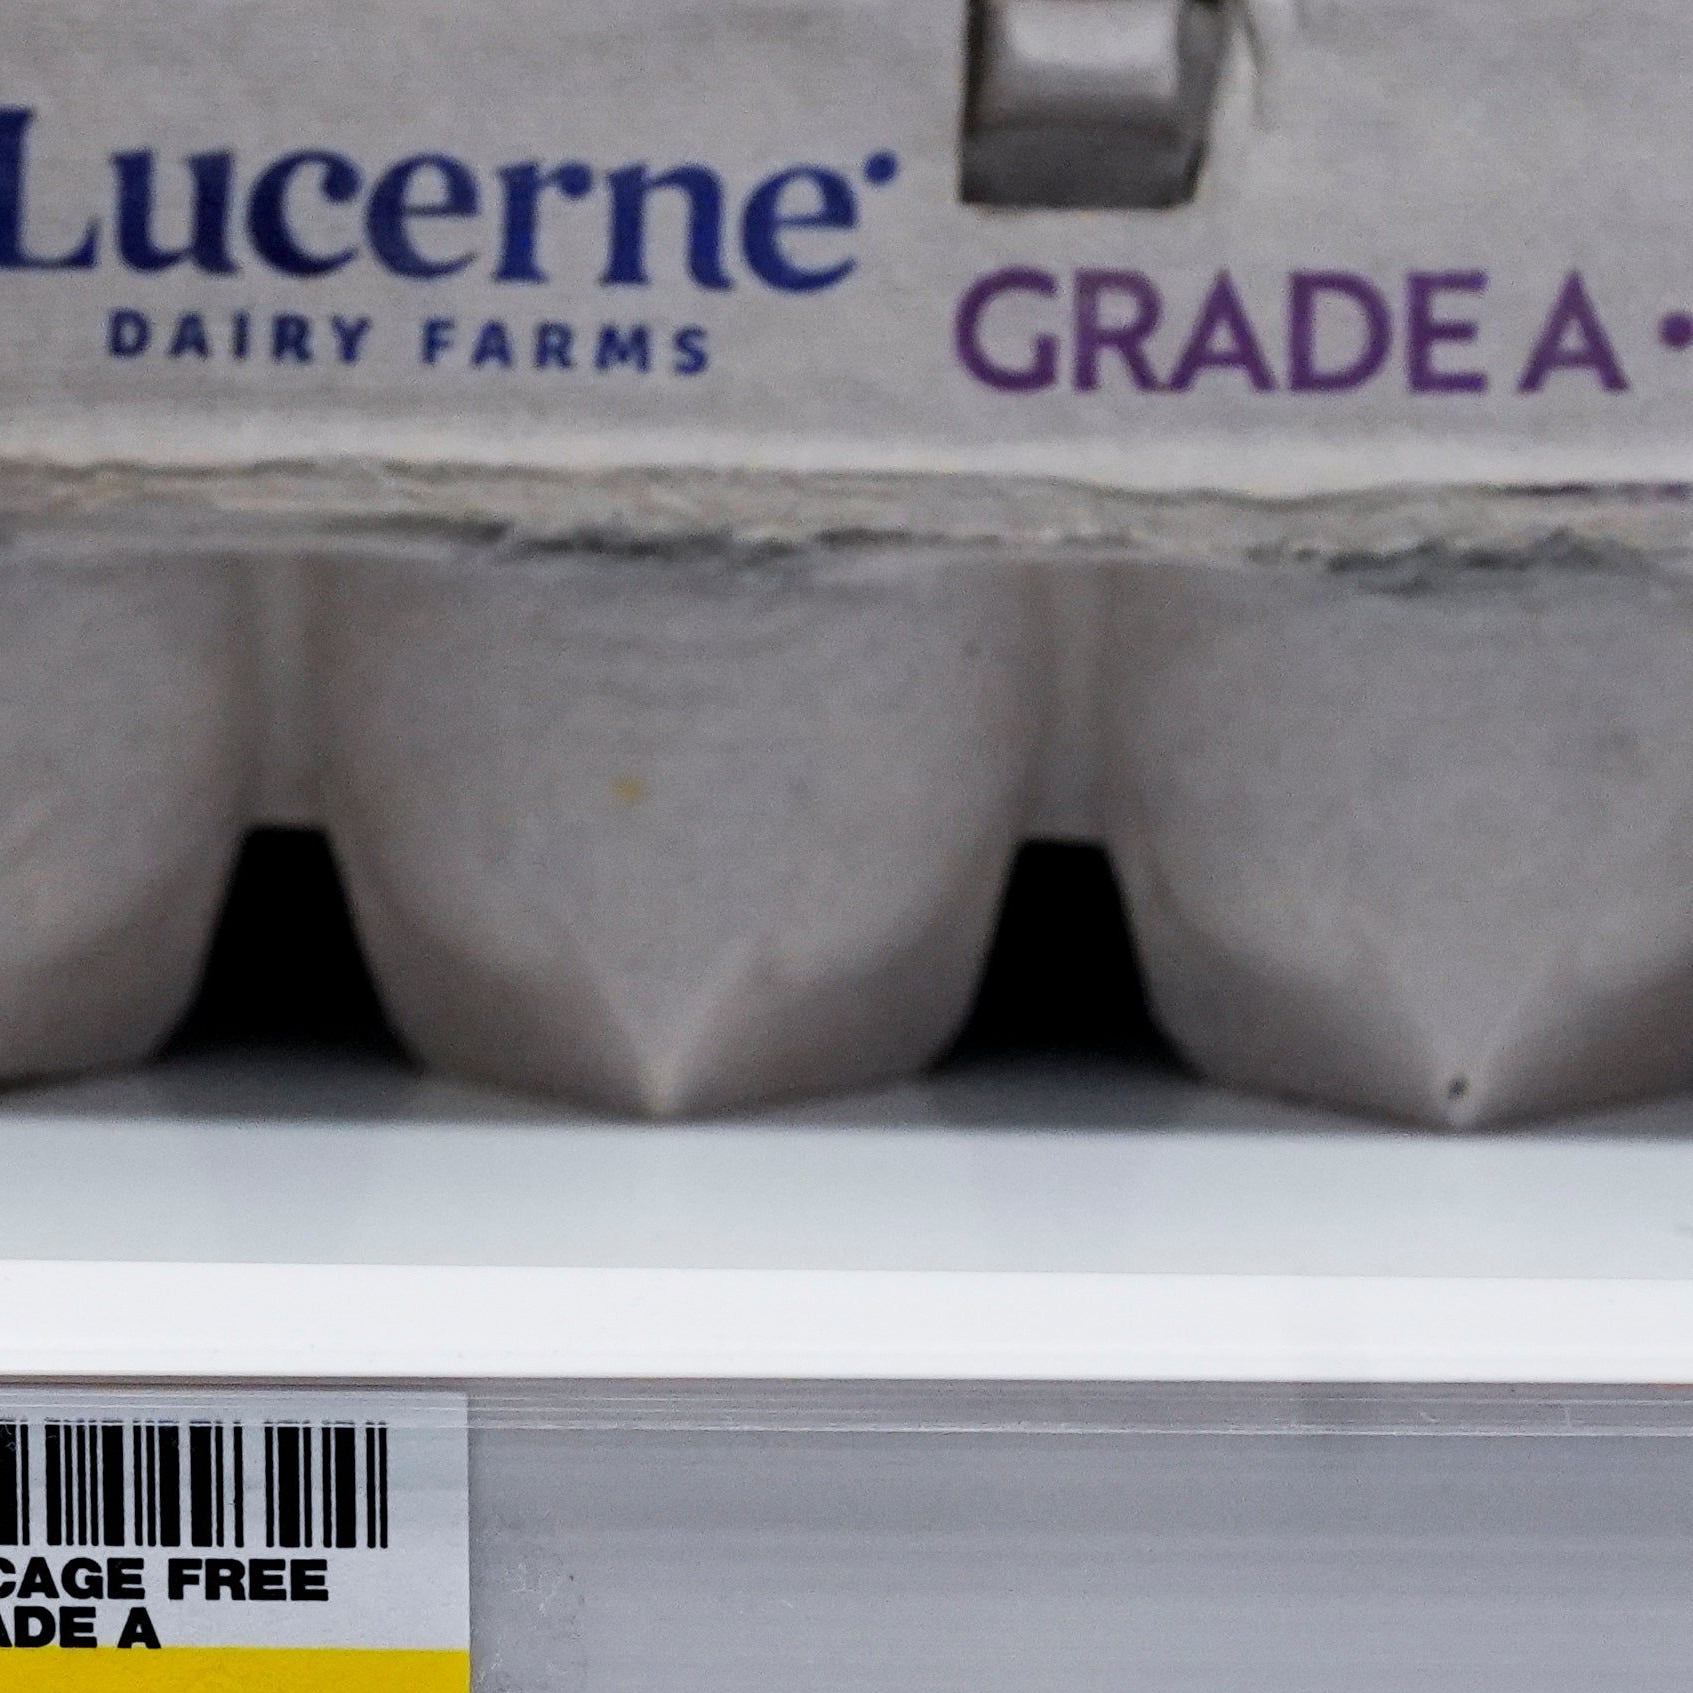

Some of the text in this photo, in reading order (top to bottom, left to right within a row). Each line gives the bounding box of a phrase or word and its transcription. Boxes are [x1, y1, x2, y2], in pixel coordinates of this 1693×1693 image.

[107, 308, 711, 375] DAIRY FARMS
[955, 265, 1628, 394] GRADE A
[167, 1558, 329, 1601] FREE
[117, 1607, 162, 1649] A
